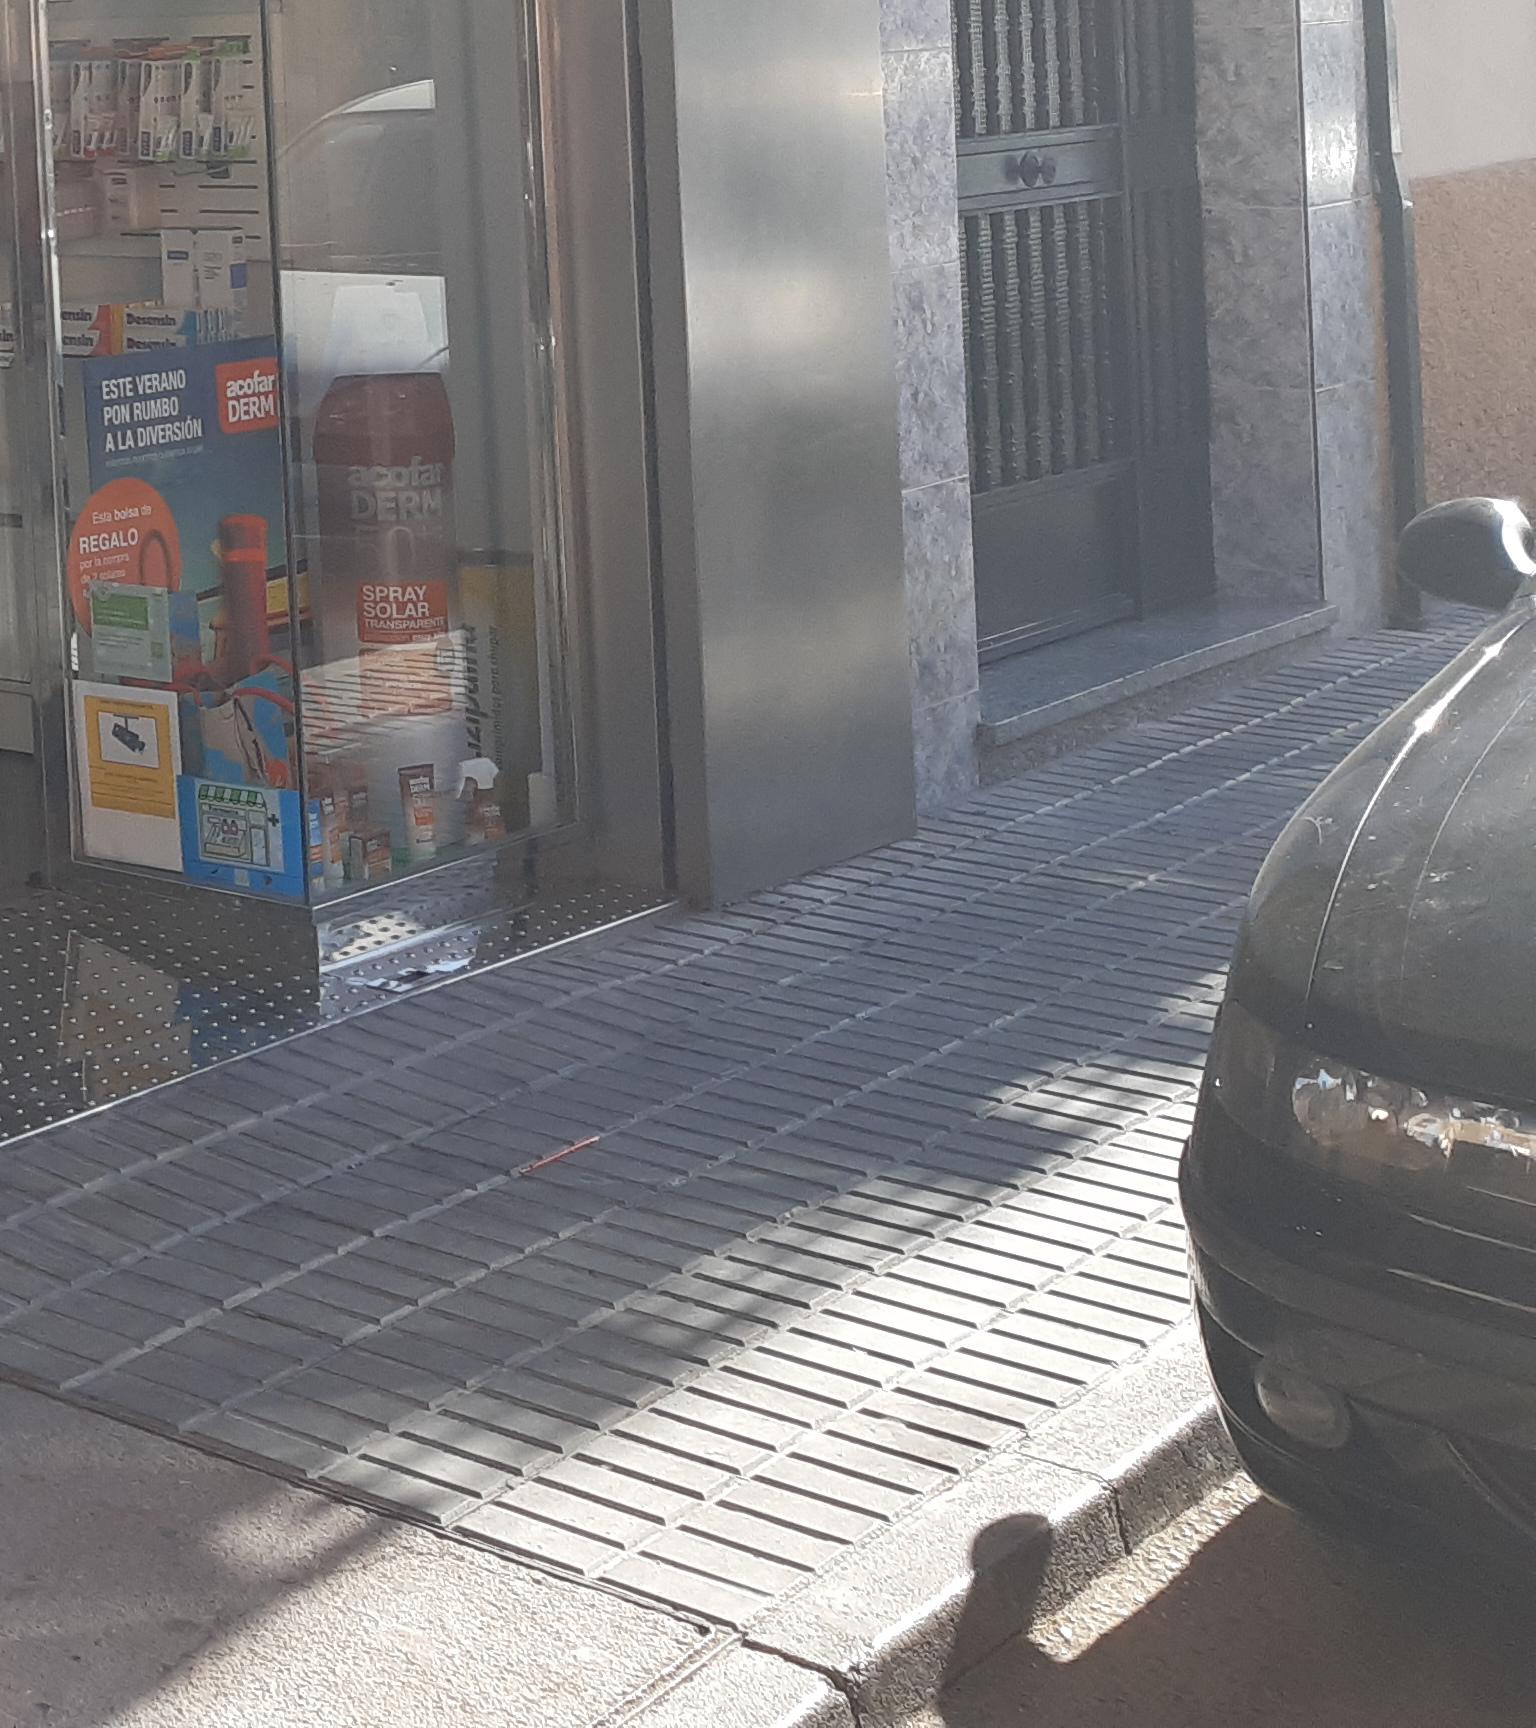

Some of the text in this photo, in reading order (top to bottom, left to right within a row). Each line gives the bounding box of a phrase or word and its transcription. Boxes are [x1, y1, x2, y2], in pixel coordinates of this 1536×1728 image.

[126, 311, 177, 327] Desensin
[101, 369, 187, 401] ESTE VERANO
[226, 369, 276, 399] acofar
[103, 396, 179, 427] PON RUMBO
[228, 394, 275, 423] DERM
[105, 415, 203, 453] A LA DIVERSIÓN
[92, 504, 152, 524] Esta bolsa de
[350, 488, 443, 522] DERM
[79, 527, 140, 554] REGALO
[362, 584, 427, 602] SPRAY
[363, 602, 430, 619] SOLAR
[364, 616, 445, 630] TRANSPARENTE
